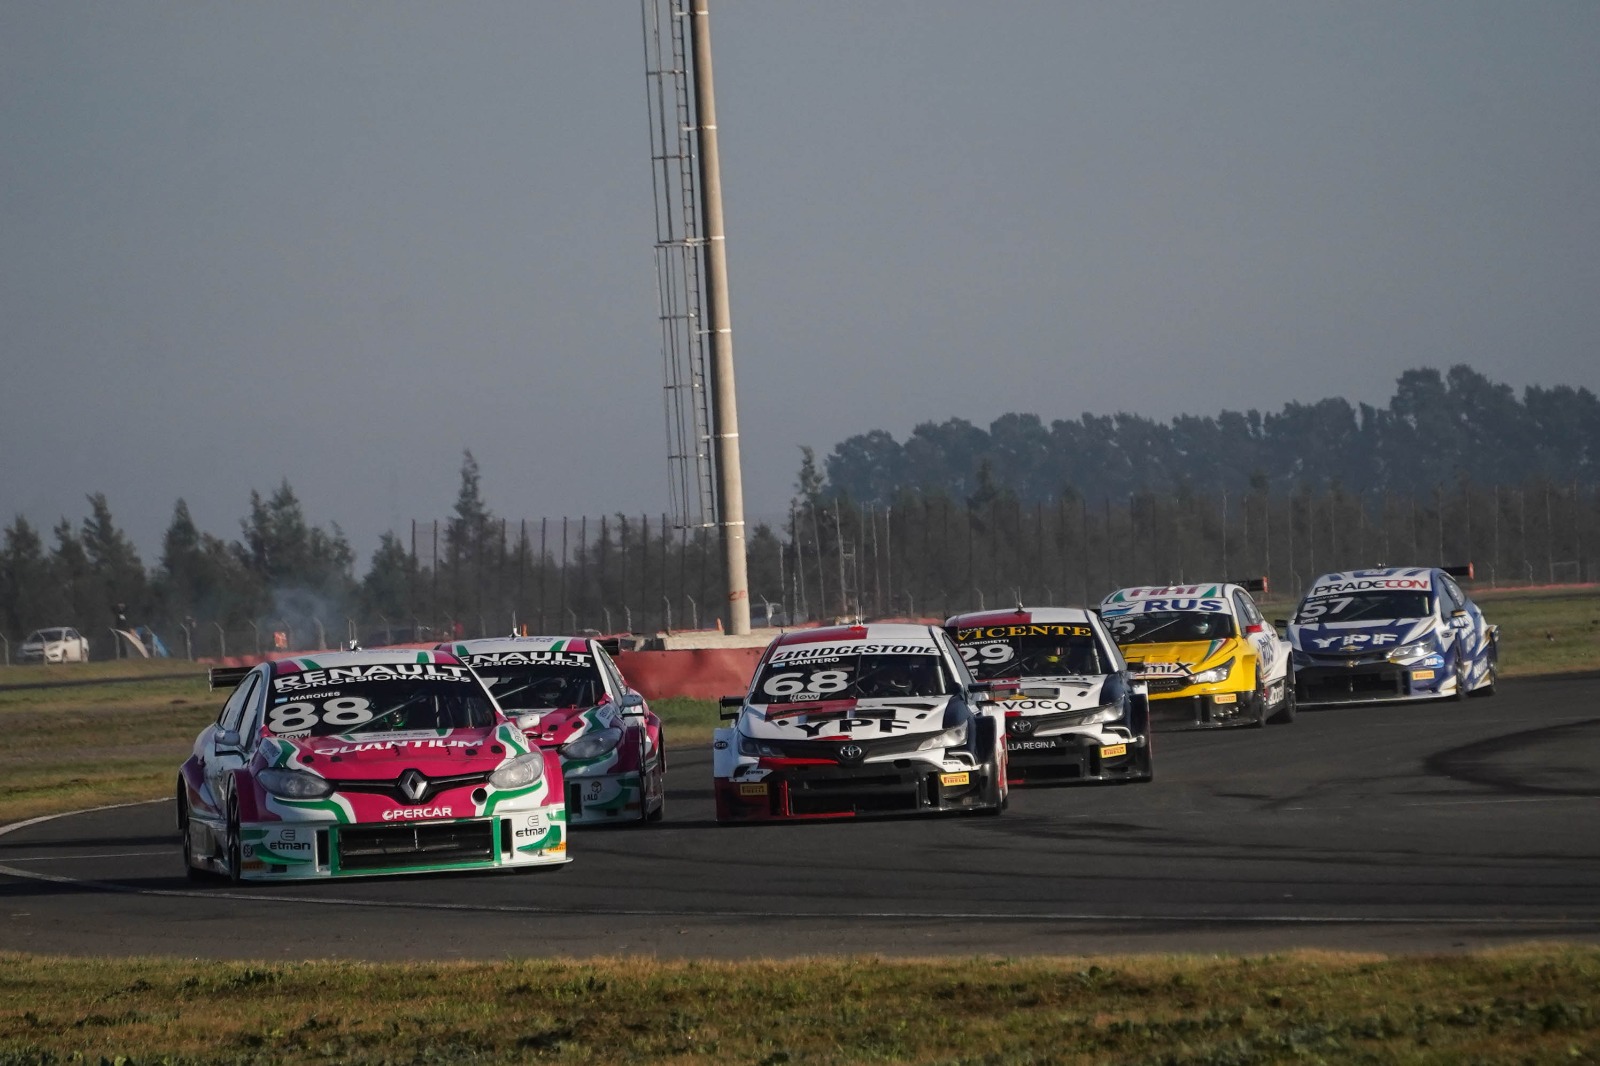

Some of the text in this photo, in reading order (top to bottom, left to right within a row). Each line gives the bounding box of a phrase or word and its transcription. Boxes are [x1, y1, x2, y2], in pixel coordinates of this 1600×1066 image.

[1313, 579, 1428, 596] PRADECON
[1143, 599, 1223, 612] RUS
[1300, 597, 1354, 618] 57
[957, 625, 1092, 641] VICENTE
[1312, 633, 1398, 649] YPF
[773, 644, 939, 663] BRIDGESTONE
[788, 657, 840, 667] SANTERO
[957, 643, 1015, 667] 29
[467, 659, 591, 668] CESIONARIOS
[273, 664, 468, 690] RENAULT
[276, 673, 472, 694] CONCESIONARIOS
[763, 670, 849, 697] 68
[289, 691, 341, 702] MARQUES
[791, 692, 820, 701] flow
[268, 696, 374, 734] 88
[794, 718, 911, 738] YPF
[313, 739, 485, 756] QUANTIUM
[943, 775, 968, 784] PIRELLI
